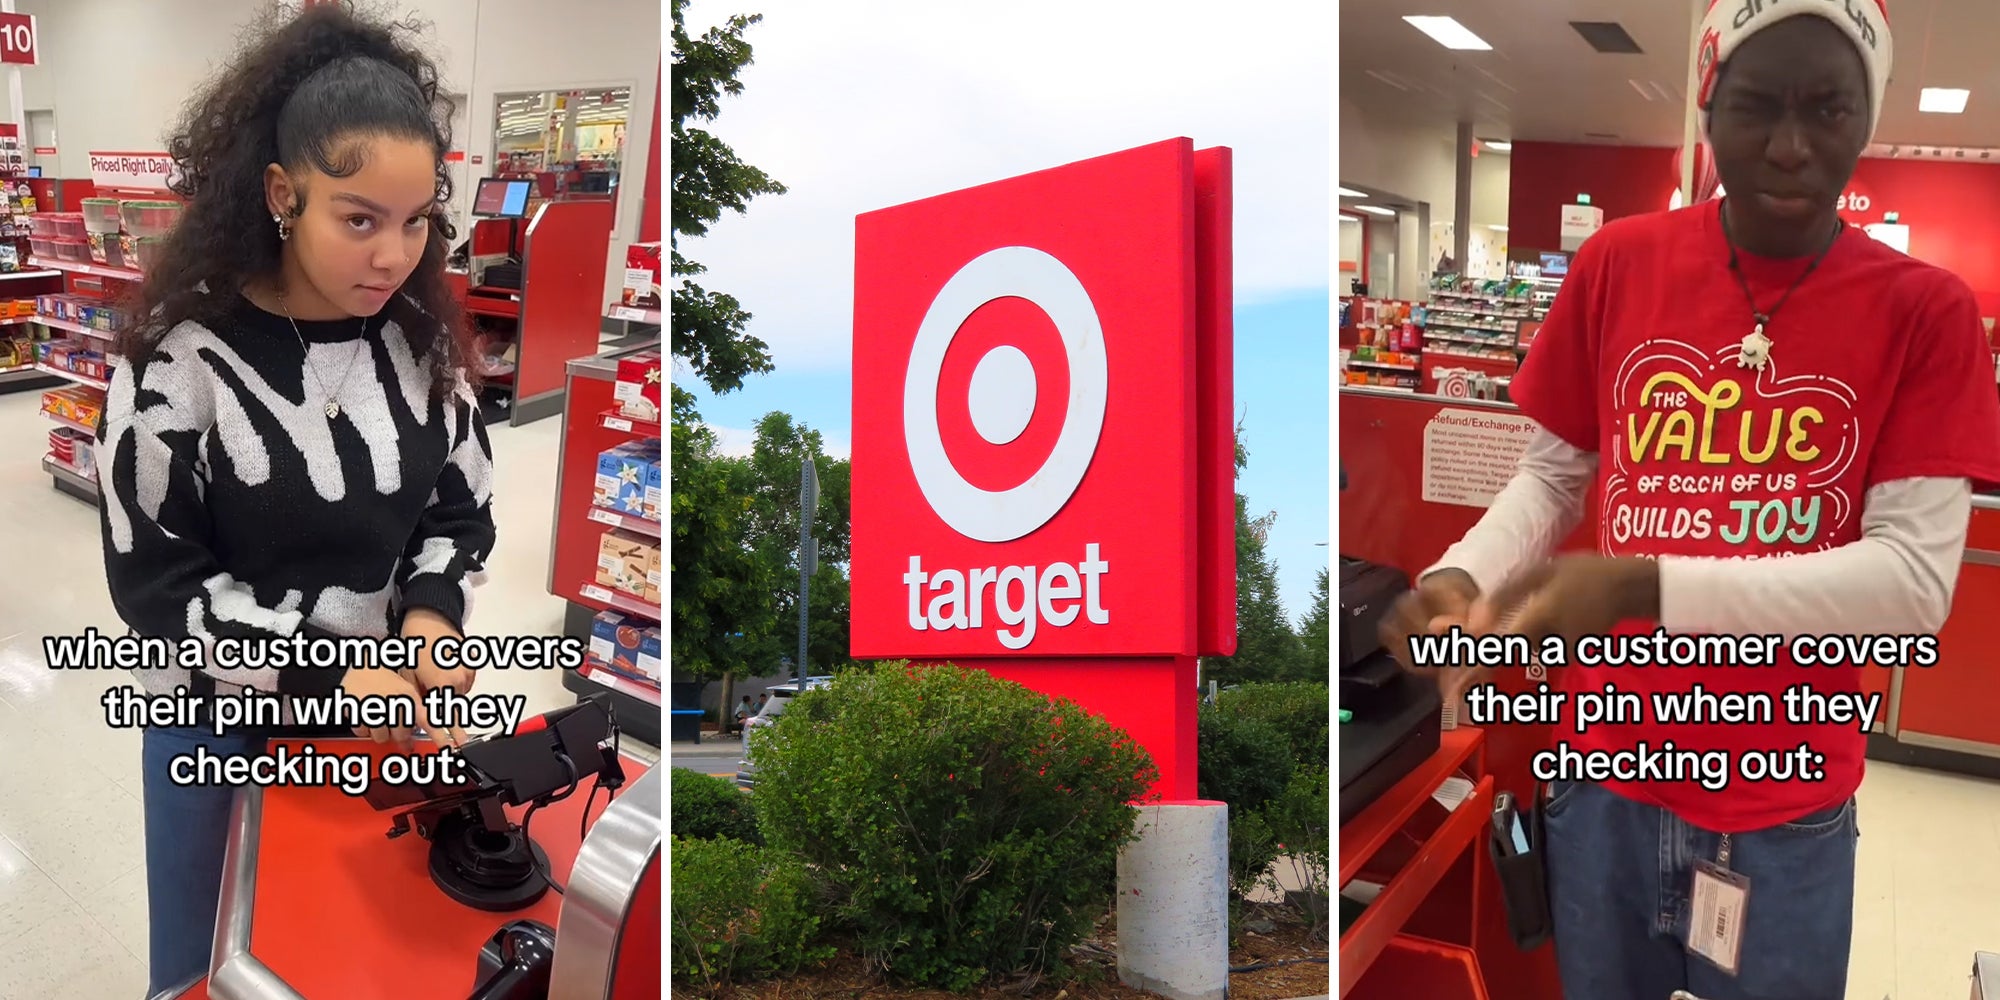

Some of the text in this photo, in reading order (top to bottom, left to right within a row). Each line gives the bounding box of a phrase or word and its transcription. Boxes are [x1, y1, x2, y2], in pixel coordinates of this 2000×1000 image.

[0, 23, 32, 53] 10
[91, 157, 173, 176] Priced Right Daily
[1848, 191, 1871, 211] to
[1653, 391, 1688, 408] THE
[1433, 414, 1521, 433] Refund/Exchange
[1628, 371, 1824, 464] VALUE
[1637, 475, 1664, 493] OF
[1731, 474, 1761, 492] OF
[1766, 473, 1797, 491] US
[1612, 495, 1821, 544] BUILDS JOY
[903, 543, 1110, 649] target
